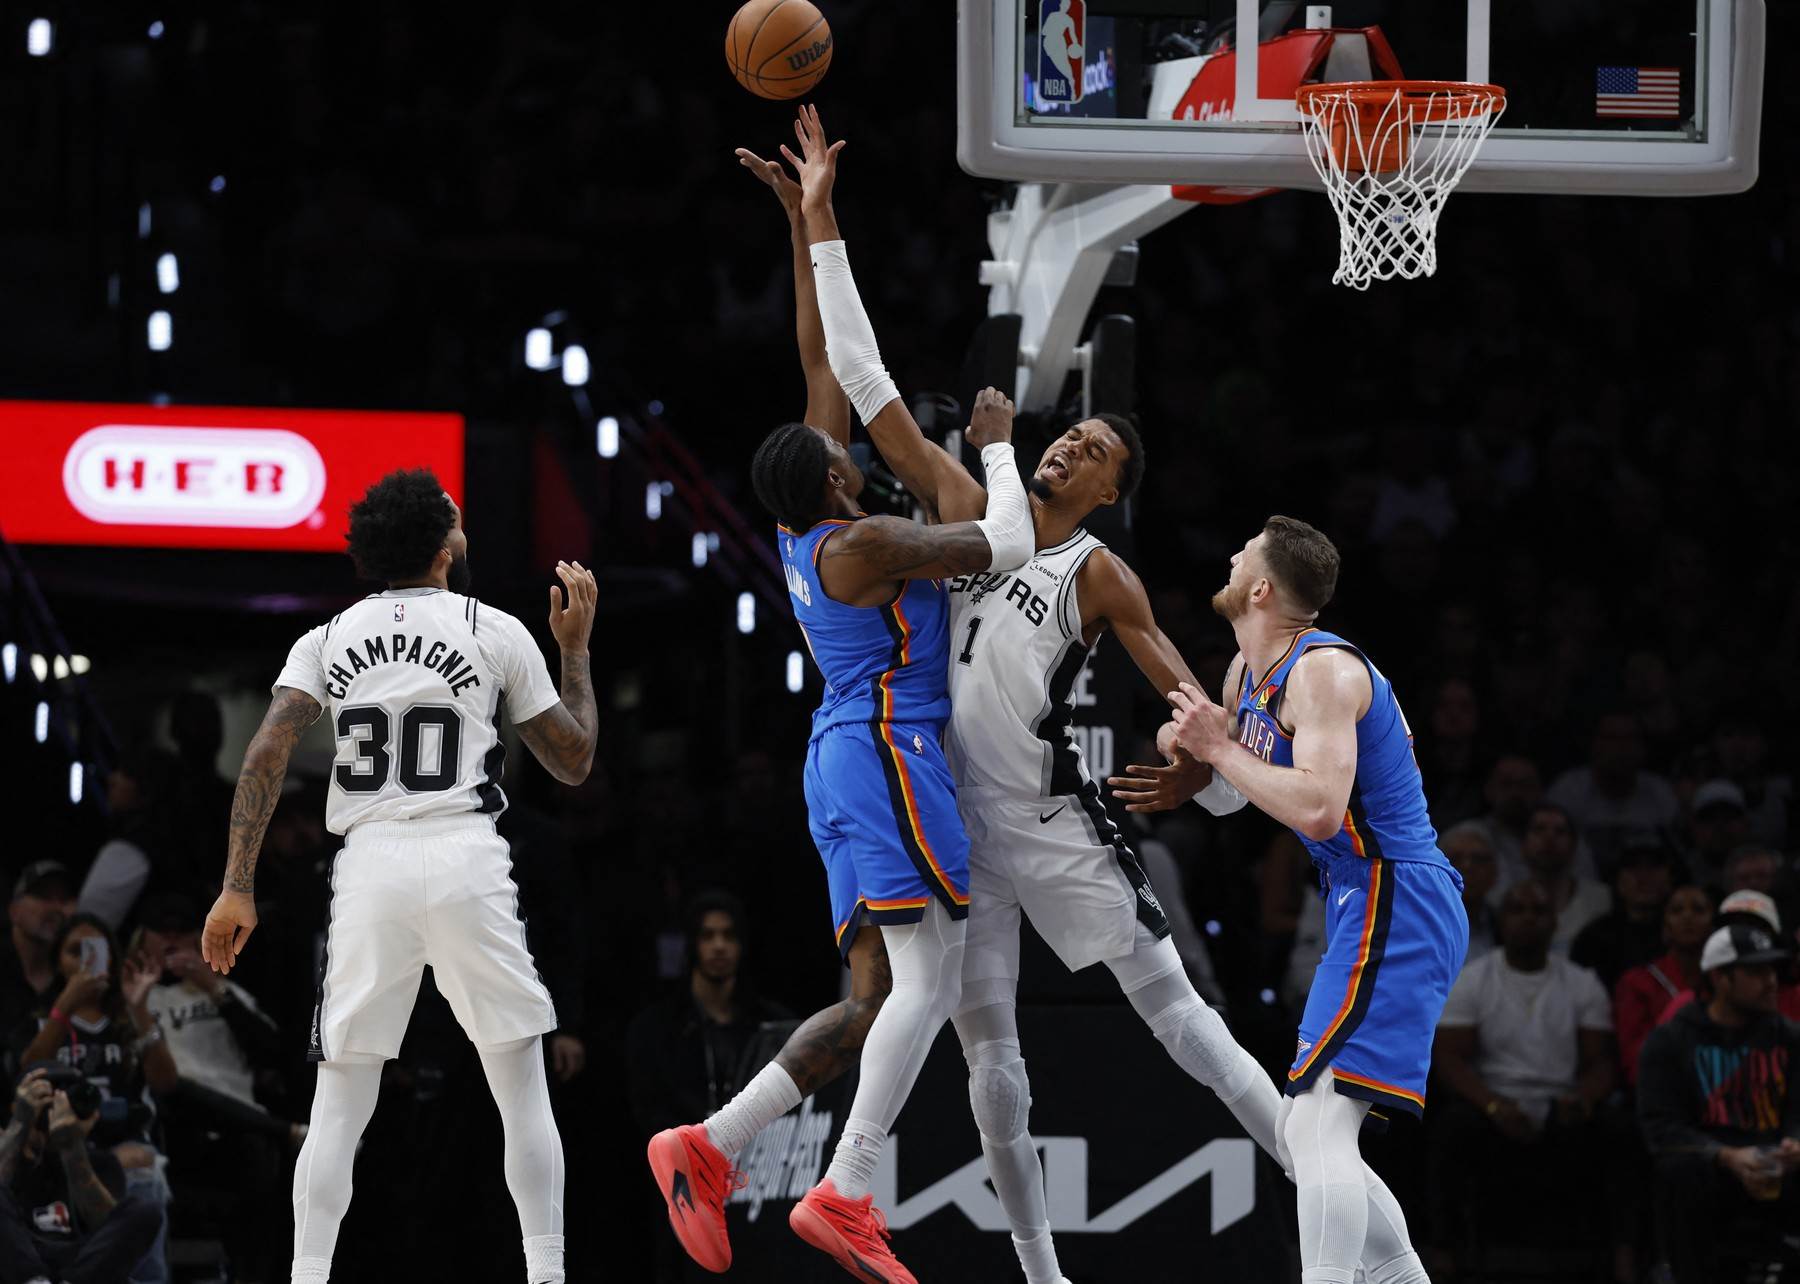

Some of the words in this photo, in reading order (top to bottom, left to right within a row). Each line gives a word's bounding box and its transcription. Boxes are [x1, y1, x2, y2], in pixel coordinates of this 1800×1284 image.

[785, 33, 832, 71] Wilso
[1044, 79, 1067, 96] NBA
[1034, 563, 1059, 582] LEDGER
[949, 572, 1049, 627] SPURS
[957, 614, 984, 667] 1
[326, 634, 481, 700] CHAMPAGNIE
[333, 703, 466, 796] 30
[1240, 712, 1275, 763] NDER
